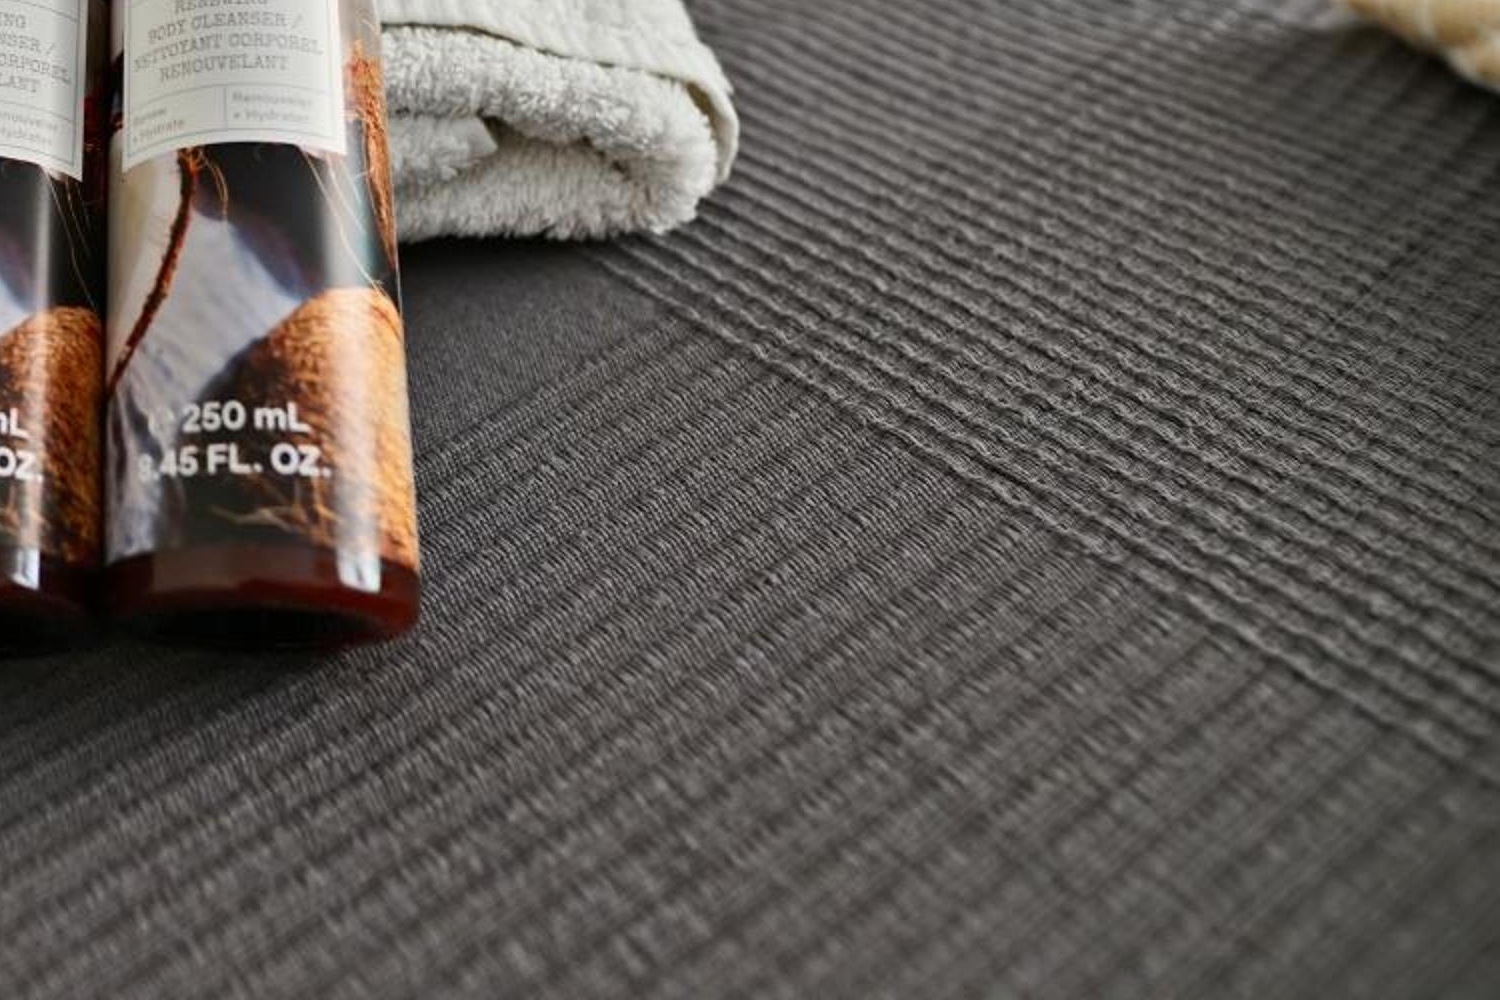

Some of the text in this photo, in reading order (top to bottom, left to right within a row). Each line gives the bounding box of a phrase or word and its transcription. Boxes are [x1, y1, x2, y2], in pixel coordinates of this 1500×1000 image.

[147, 18, 187, 44] BODY
[191, 12, 287, 32] CLEANSER
[133, 33, 324, 73] NETTOYANT CORPOREL
[159, 54, 290, 83] RENOUVELANT
[182, 400, 311, 433] 250 mL
[207, 443, 263, 475] FL.
[271, 442, 332, 478] OZ.
